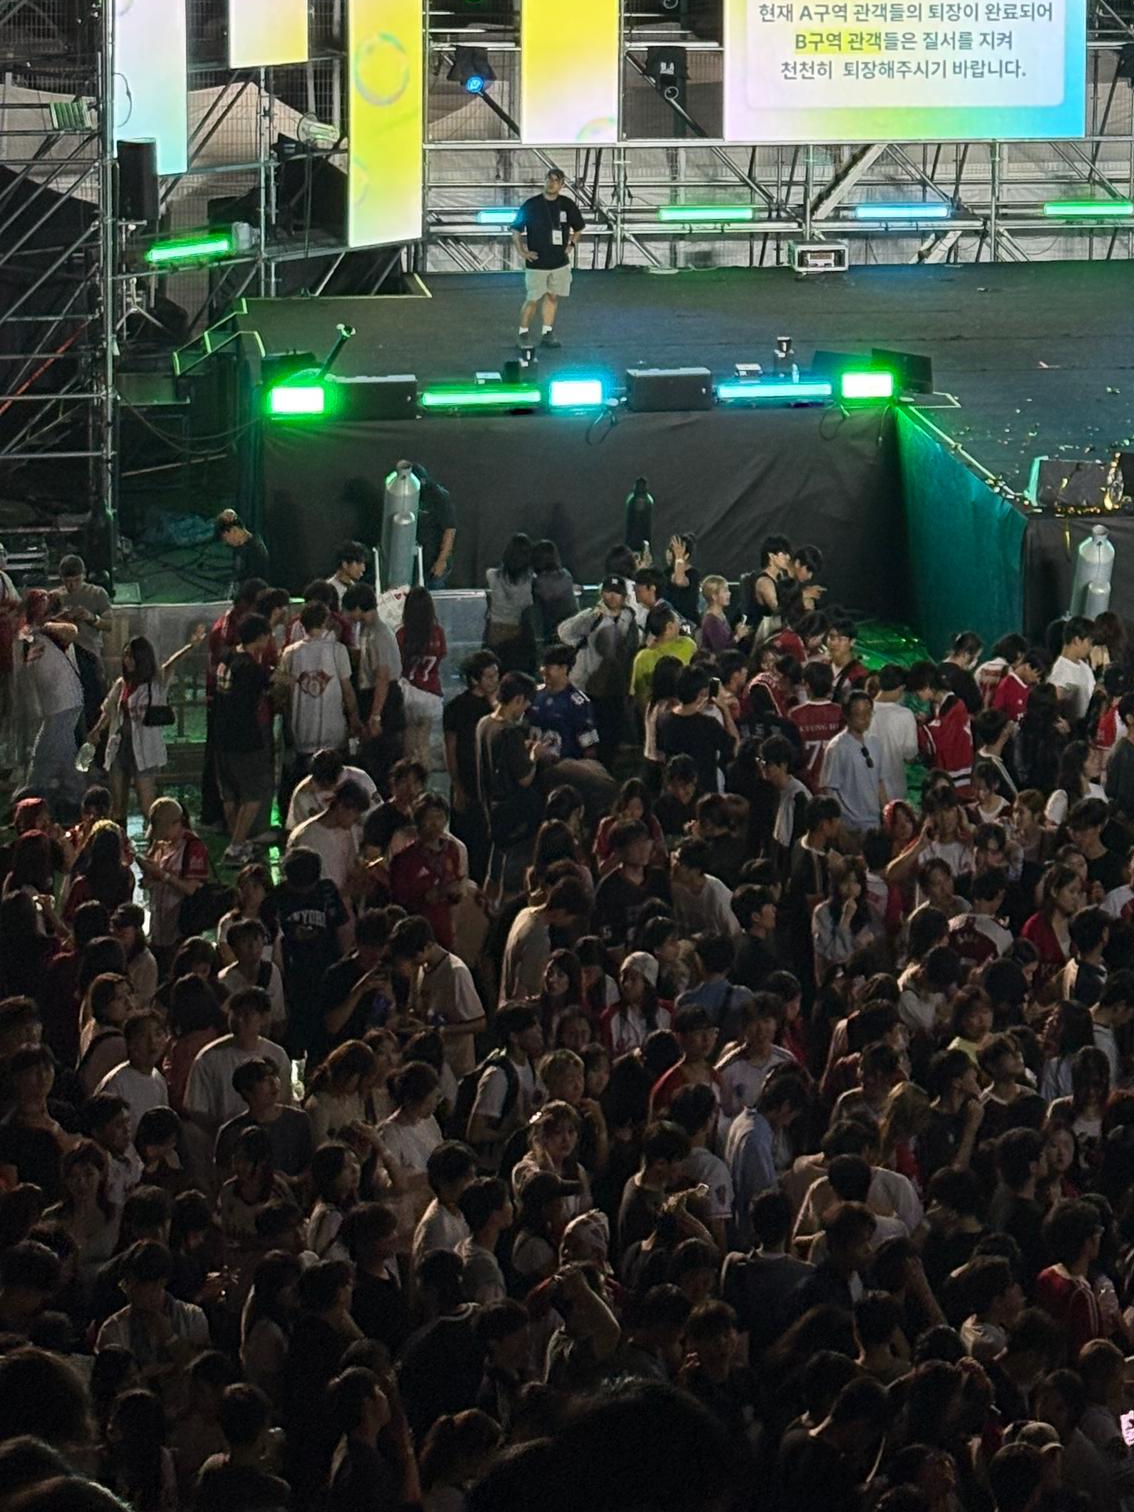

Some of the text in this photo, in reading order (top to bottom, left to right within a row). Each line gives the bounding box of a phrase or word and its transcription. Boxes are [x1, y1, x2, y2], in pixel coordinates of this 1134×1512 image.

[759, 2, 1052, 22] 현재 A구역 관객들의 퇴장이 완료되어
[796, 31, 1012, 51] B구역 관객들은 질서를 지켜
[782, 59, 1026, 80] 천천히 퇴장해주시기 바랍니다.
